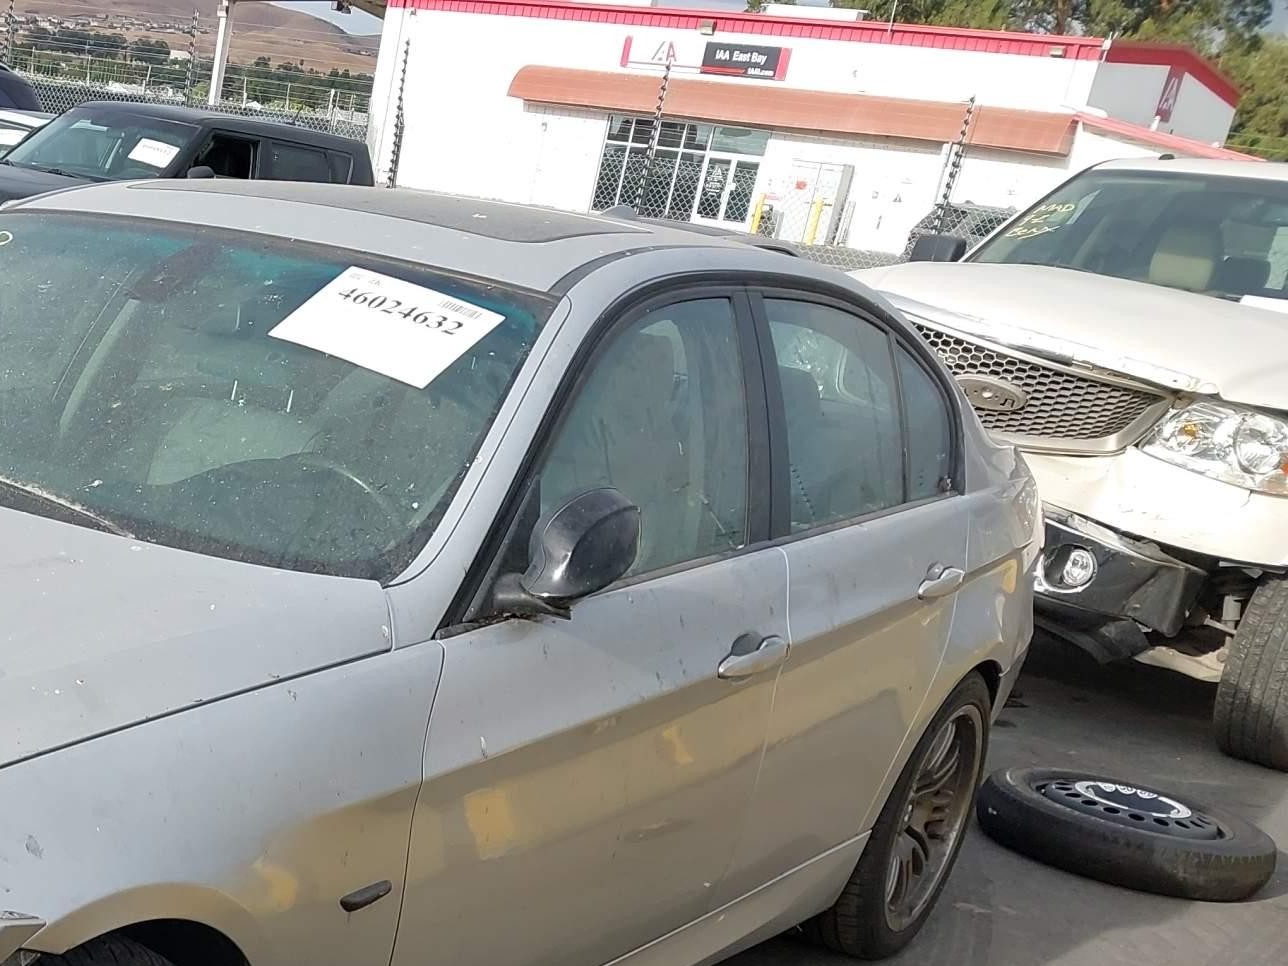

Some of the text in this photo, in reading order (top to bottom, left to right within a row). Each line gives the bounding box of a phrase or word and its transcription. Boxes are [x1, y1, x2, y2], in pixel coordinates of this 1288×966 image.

[715, 49, 768, 66] IAA East Bay
[338, 287, 464, 335] 46024632
